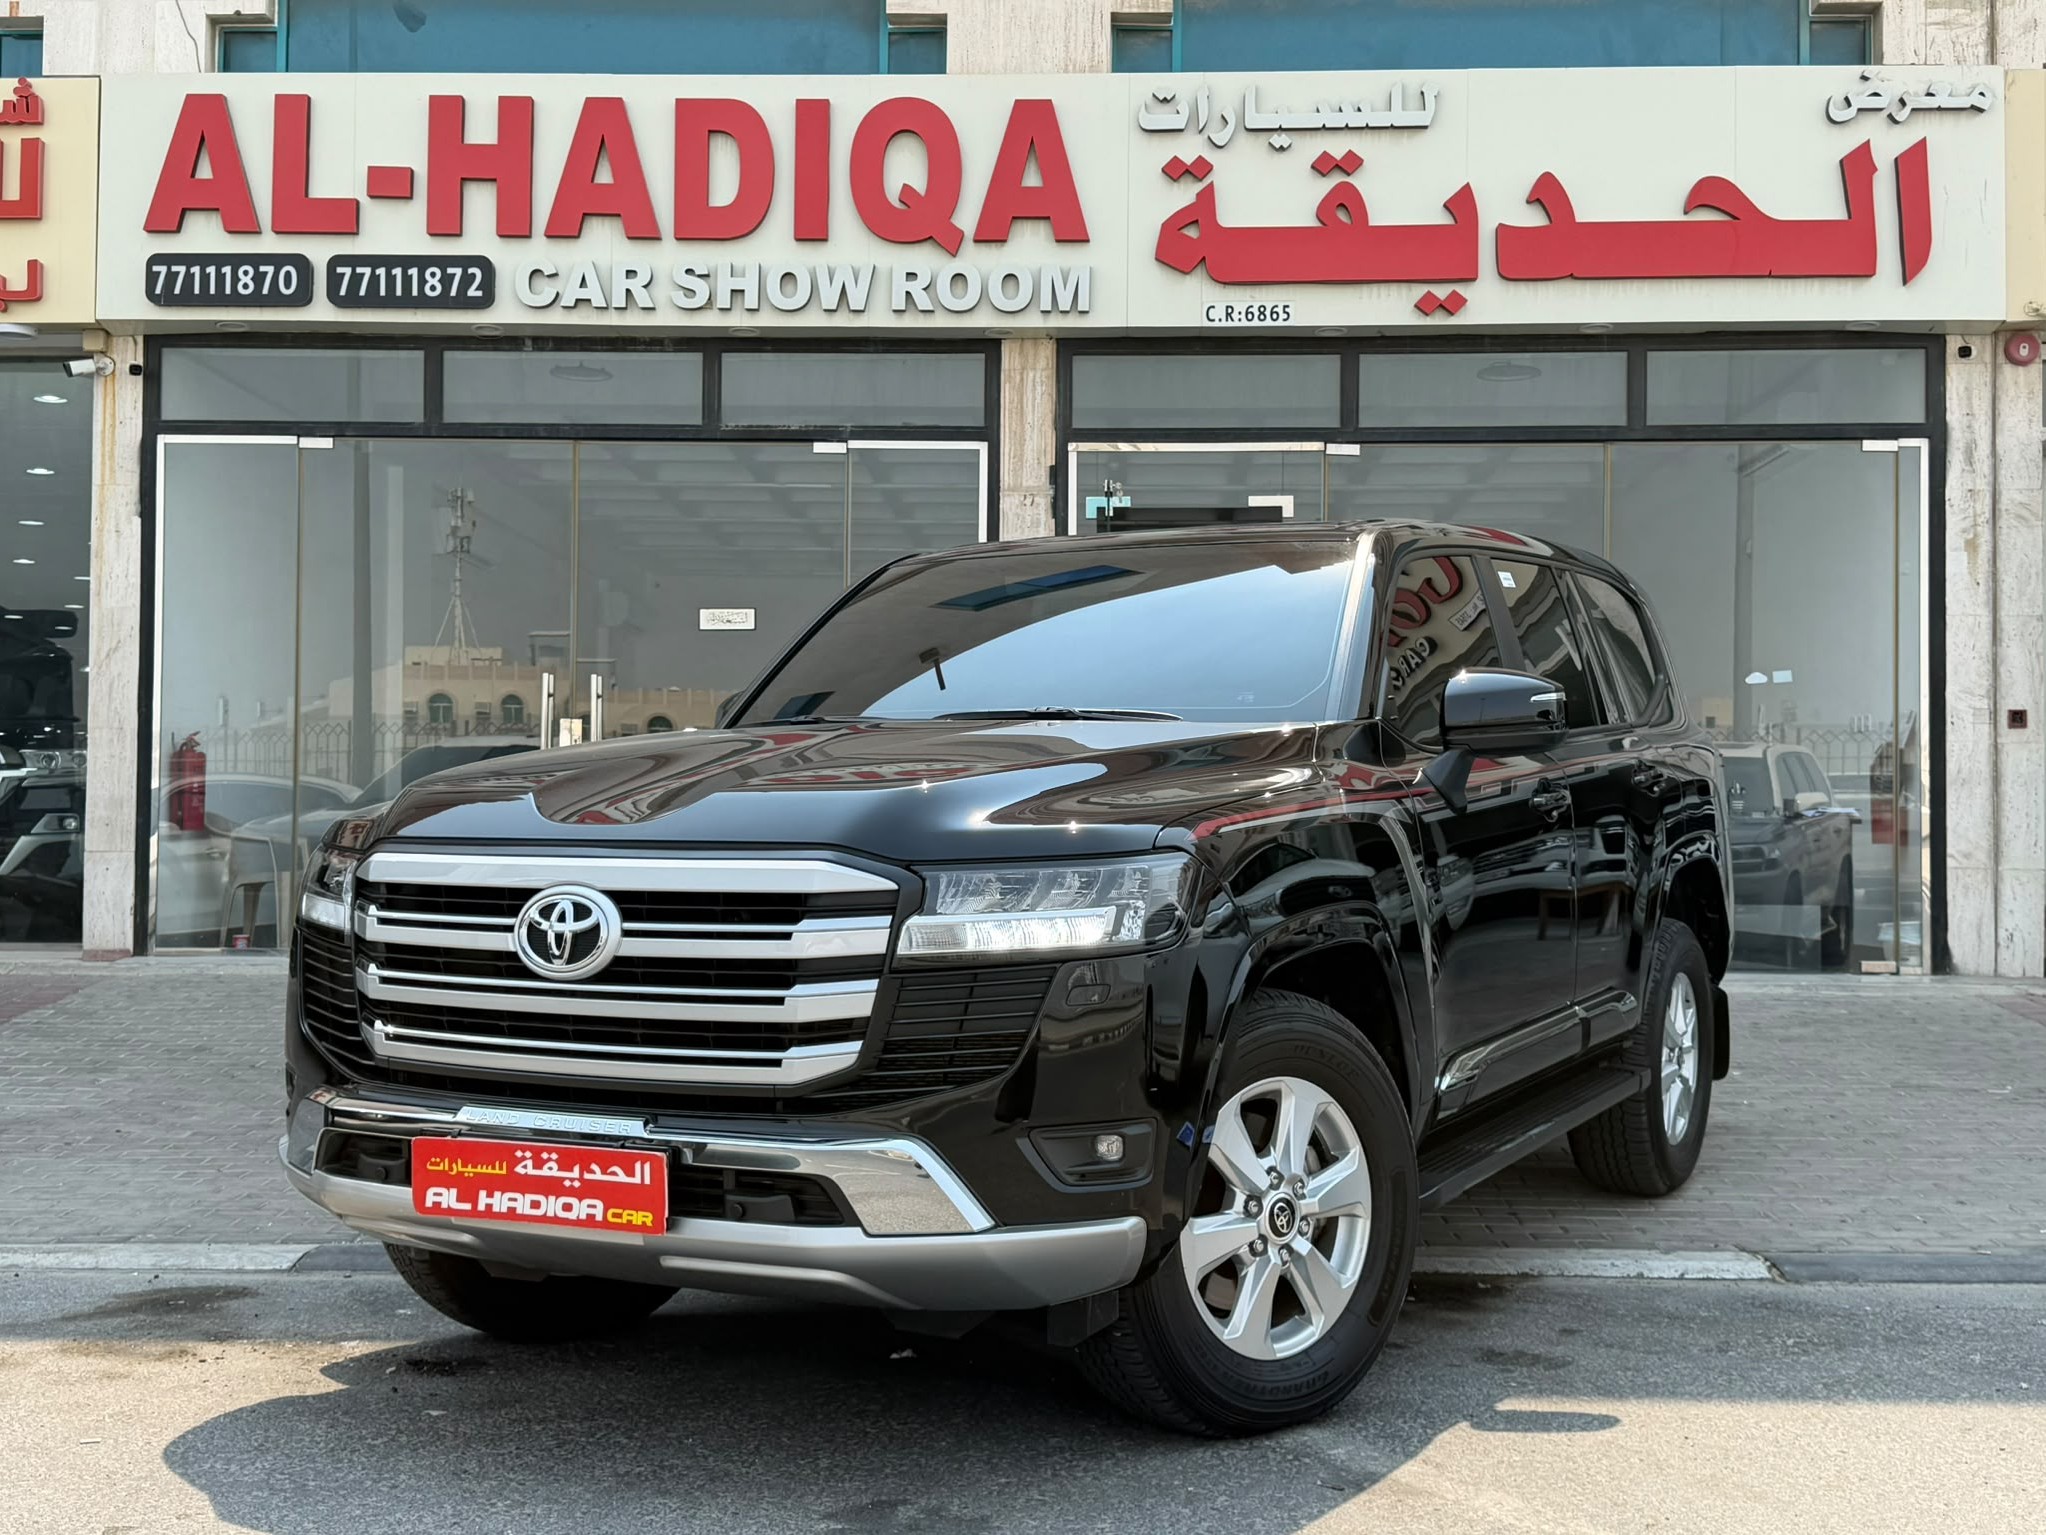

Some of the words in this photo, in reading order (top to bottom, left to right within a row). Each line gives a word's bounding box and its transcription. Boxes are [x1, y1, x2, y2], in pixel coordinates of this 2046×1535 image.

[1138, 82, 1441, 152] للسيارات
[1825, 69, 1994, 125] معرض
[143, 93, 1090, 257] AL-HADIQA
[1155, 136, 1934, 317] الحديقة
[151, 264, 299, 296] 77111870
[336, 265, 484, 298] 77111872
[515, 259, 656, 310] CAR
[670, 260, 875, 313] SHOW
[891, 263, 1092, 314] ROOM
[1205, 304, 1291, 323] C.R:6865
[466, 1109, 520, 1126] LAND
[533, 1114, 633, 1135] CRUISER
[426, 1156, 507, 1178] للسيارات
[513, 1149, 651, 1188] الحديقة
[425, 1186, 472, 1211] AL
[477, 1189, 604, 1222] HADIQA
[606, 1207, 654, 1227] CAR
